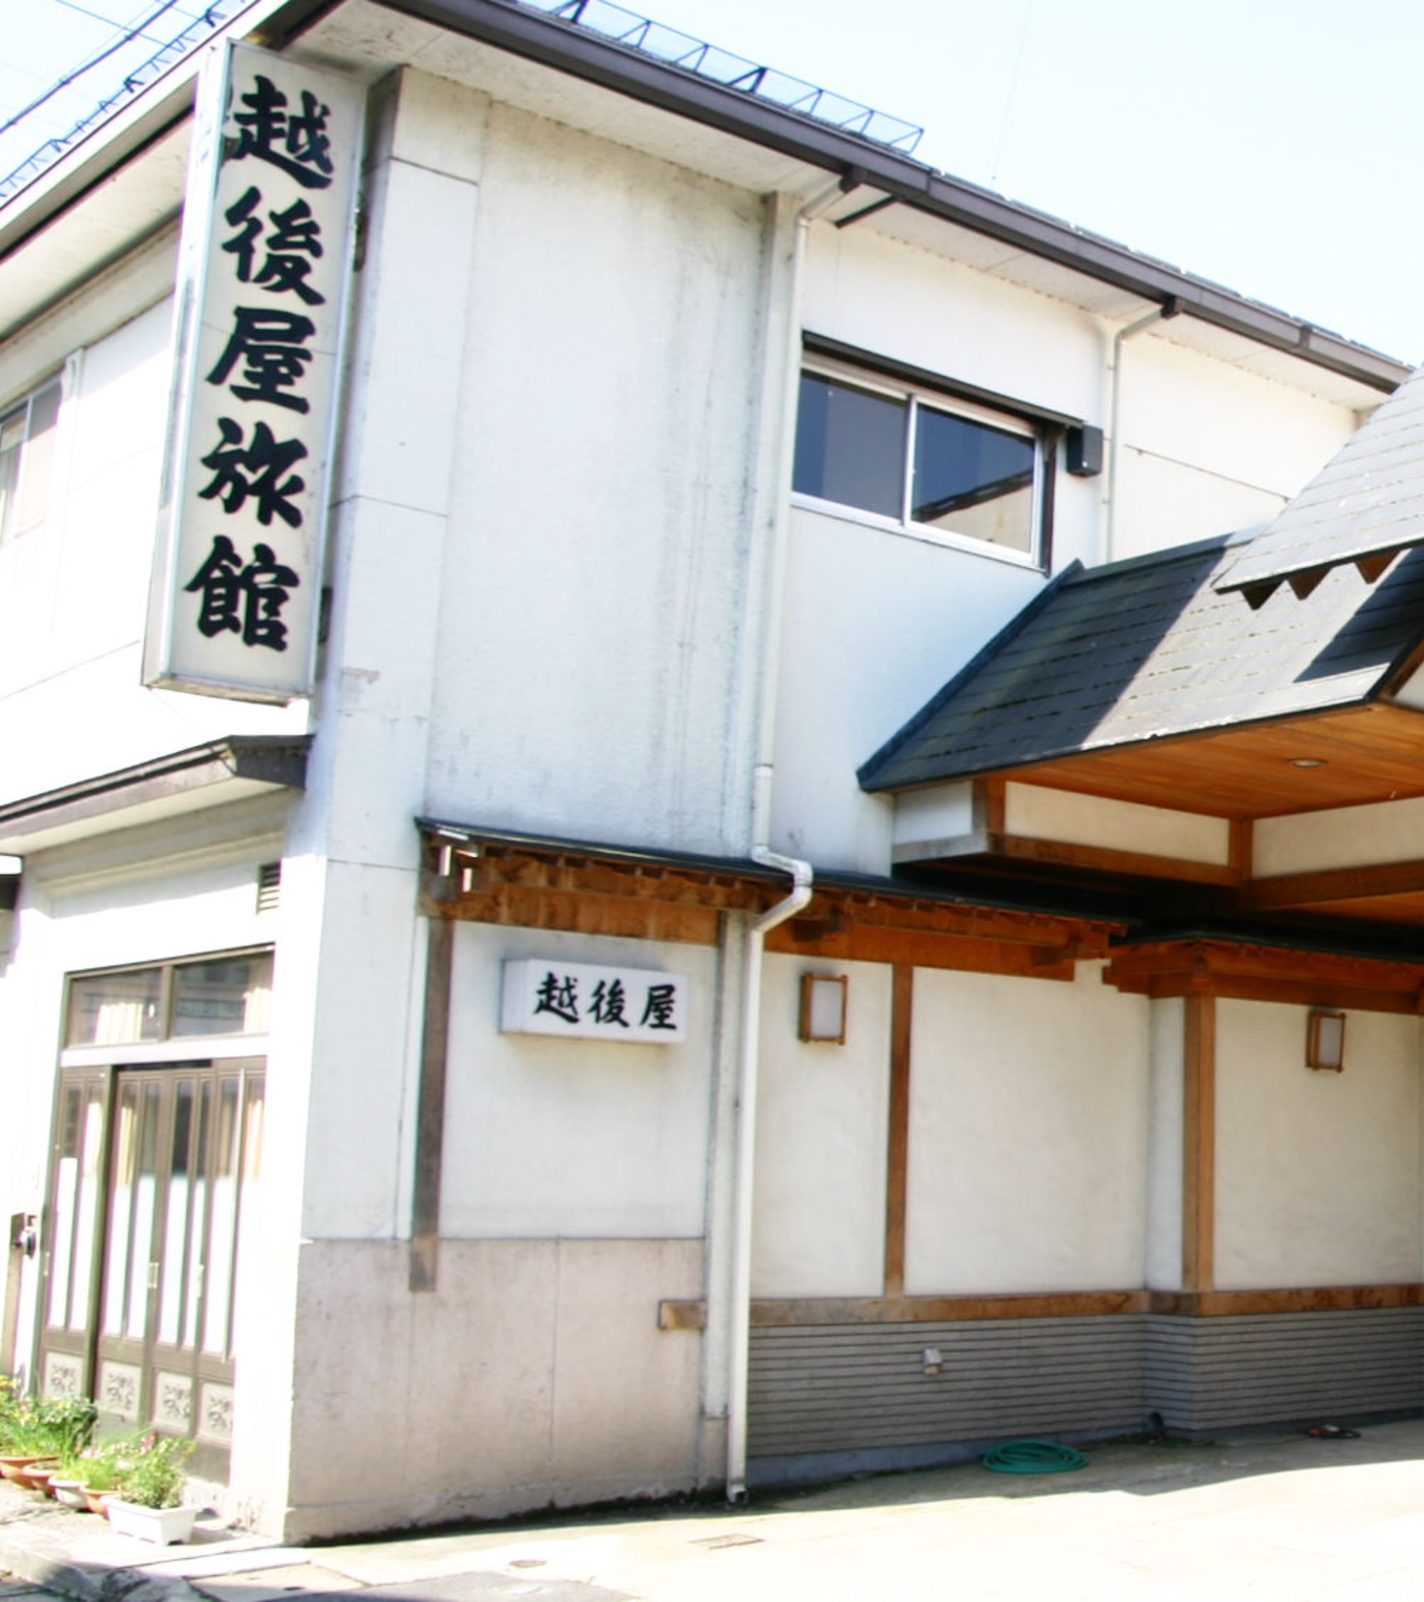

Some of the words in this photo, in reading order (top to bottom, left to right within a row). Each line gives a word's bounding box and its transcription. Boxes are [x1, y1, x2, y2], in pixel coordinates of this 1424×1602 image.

[183, 73, 334, 652] 越後屋旅館
[533, 971, 678, 1031] 越後屋
